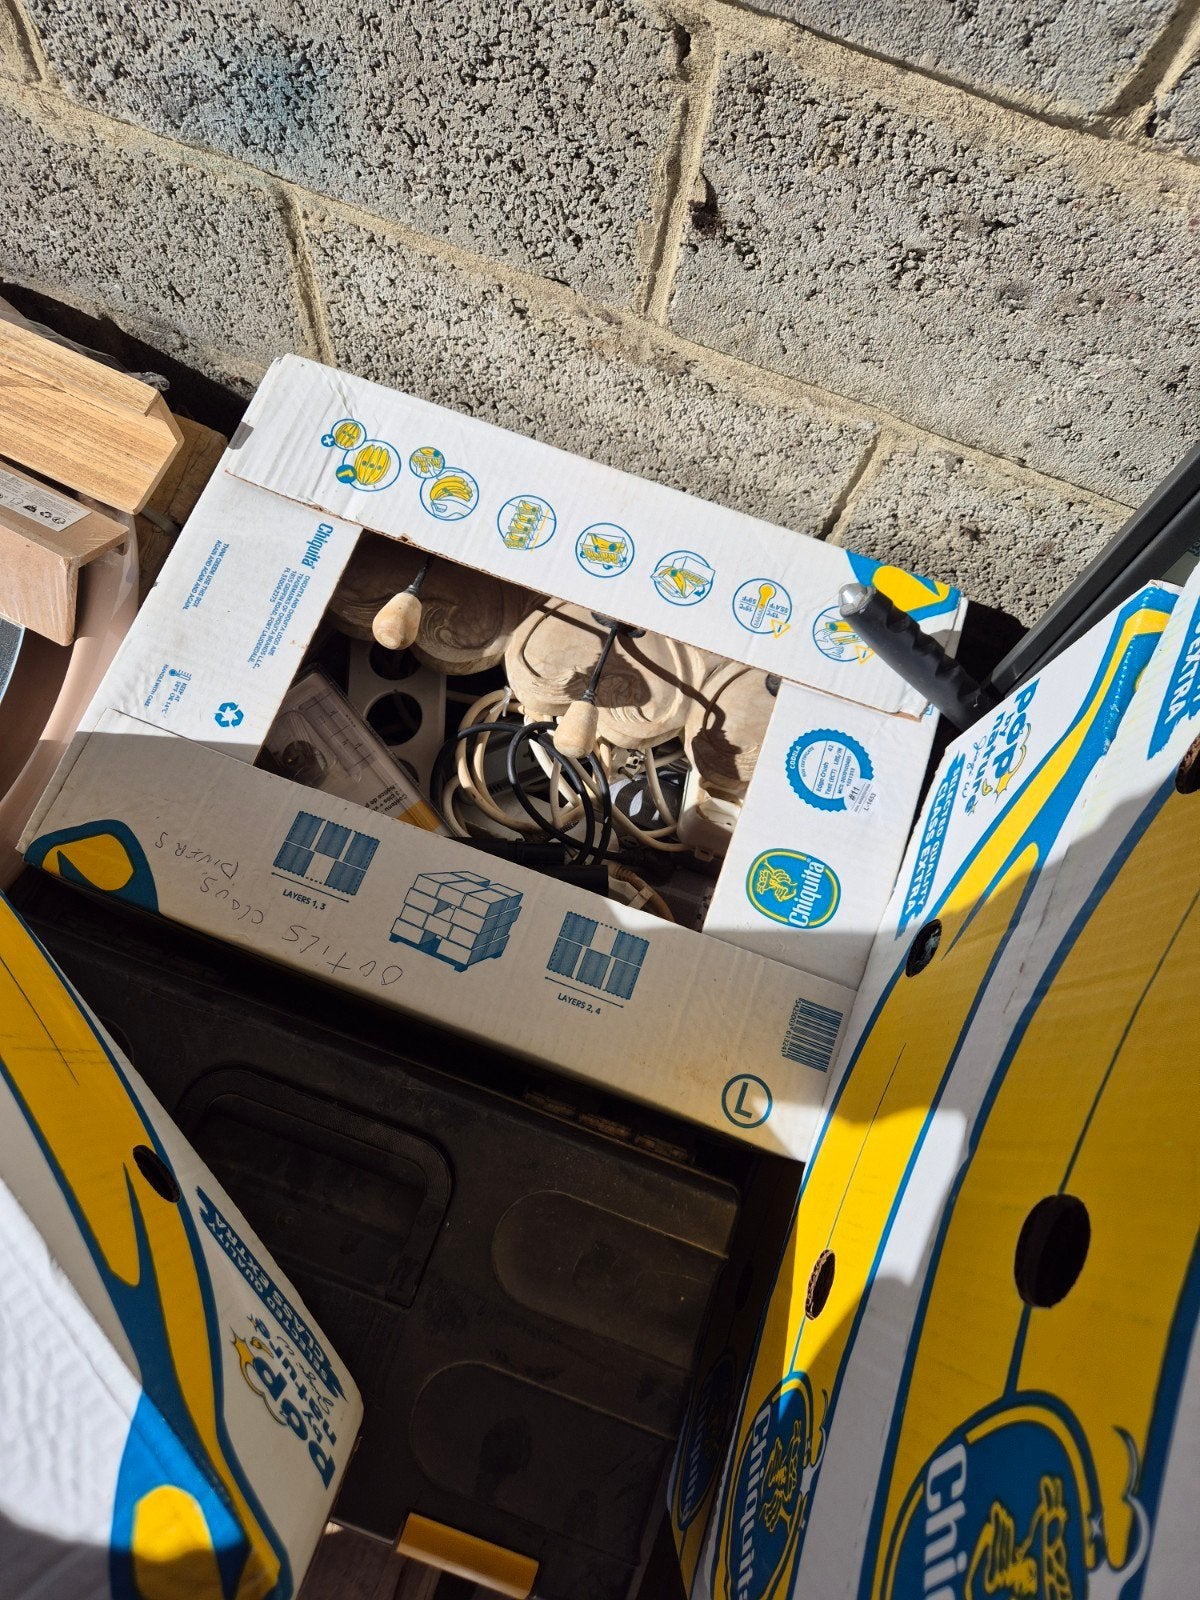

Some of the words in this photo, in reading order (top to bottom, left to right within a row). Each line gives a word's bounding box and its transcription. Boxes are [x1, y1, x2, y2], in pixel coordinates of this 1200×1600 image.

[210, 539, 222, 555] AGAIN
[218, 542, 229, 557] THINK
[301, 522, 334, 569] Chiquita
[205, 555, 214, 566] AND
[197, 565, 208, 582] AGAIN
[204, 574, 212, 585] USE
[191, 581, 200, 593] AND
[284, 572, 303, 605] TRADEMARKS
[296, 575, 310, 597] CHIQUITA
[192, 596, 201, 608] BOX
[280, 604, 288, 612] OF
[290, 597, 300, 609] AND
[264, 616, 274, 629] FORT
[269, 611, 284, 635] CHIQUITA
[279, 608, 294, 631] CHIQUITA
[259, 634, 273, 656] BRANDS
[272, 631, 283, 646] LOGO
[267, 645, 276, 656] ARE
[177, 682, 187, 695] KEEP
[1164, 638, 1200, 725] EXTRA
[174, 694, 181, 702] AT
[992, 678, 1040, 778] pop
[820, 761, 829, 777] Crush
[964, 710, 1006, 815] nature
[824, 782, 832, 794] Test
[925, 780, 947, 843] CLASS
[936, 766, 960, 838] SELECTED
[905, 848, 930, 915] EXTRA
[916, 841, 940, 905] QUALITY
[282, 888, 311, 906] LAYERS
[787, 857, 826, 928] Chiquita
[557, 992, 586, 1008] LAYERS
[735, 1082, 752, 1118] L
[209, 1222, 263, 1294] QUALITY
[214, 1212, 270, 1288] EXTRA
[272, 1290, 324, 1358] CLASS
[266, 1299, 328, 1381] SELECTED
[254, 1316, 337, 1446] nature
[252, 1356, 336, 1490] pop
[302, 1410, 323, 1444] by
[924, 1443, 967, 1600] Chi
